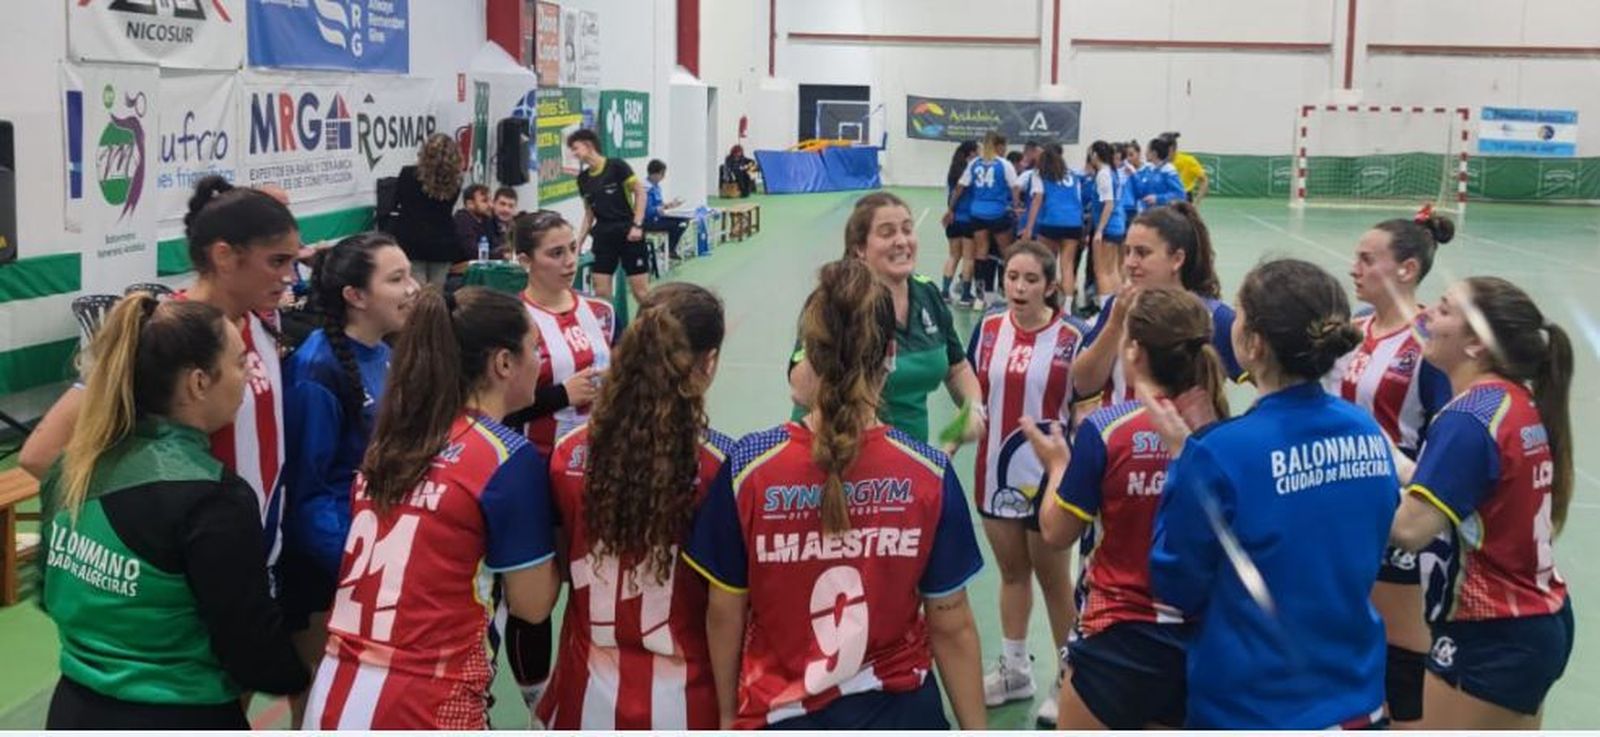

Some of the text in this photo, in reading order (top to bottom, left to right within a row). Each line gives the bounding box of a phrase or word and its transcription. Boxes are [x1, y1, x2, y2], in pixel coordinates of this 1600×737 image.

[126, 21, 193, 43] NICOSUR
[249, 92, 322, 154] MRG
[974, 166, 994, 188] 34
[1010, 345, 1033, 373] 13
[1276, 468, 1324, 494] CIUDAD
[77, 564, 138, 597] ALGECIRAS
[328, 509, 420, 643] 21
[804, 565, 868, 695] 9
